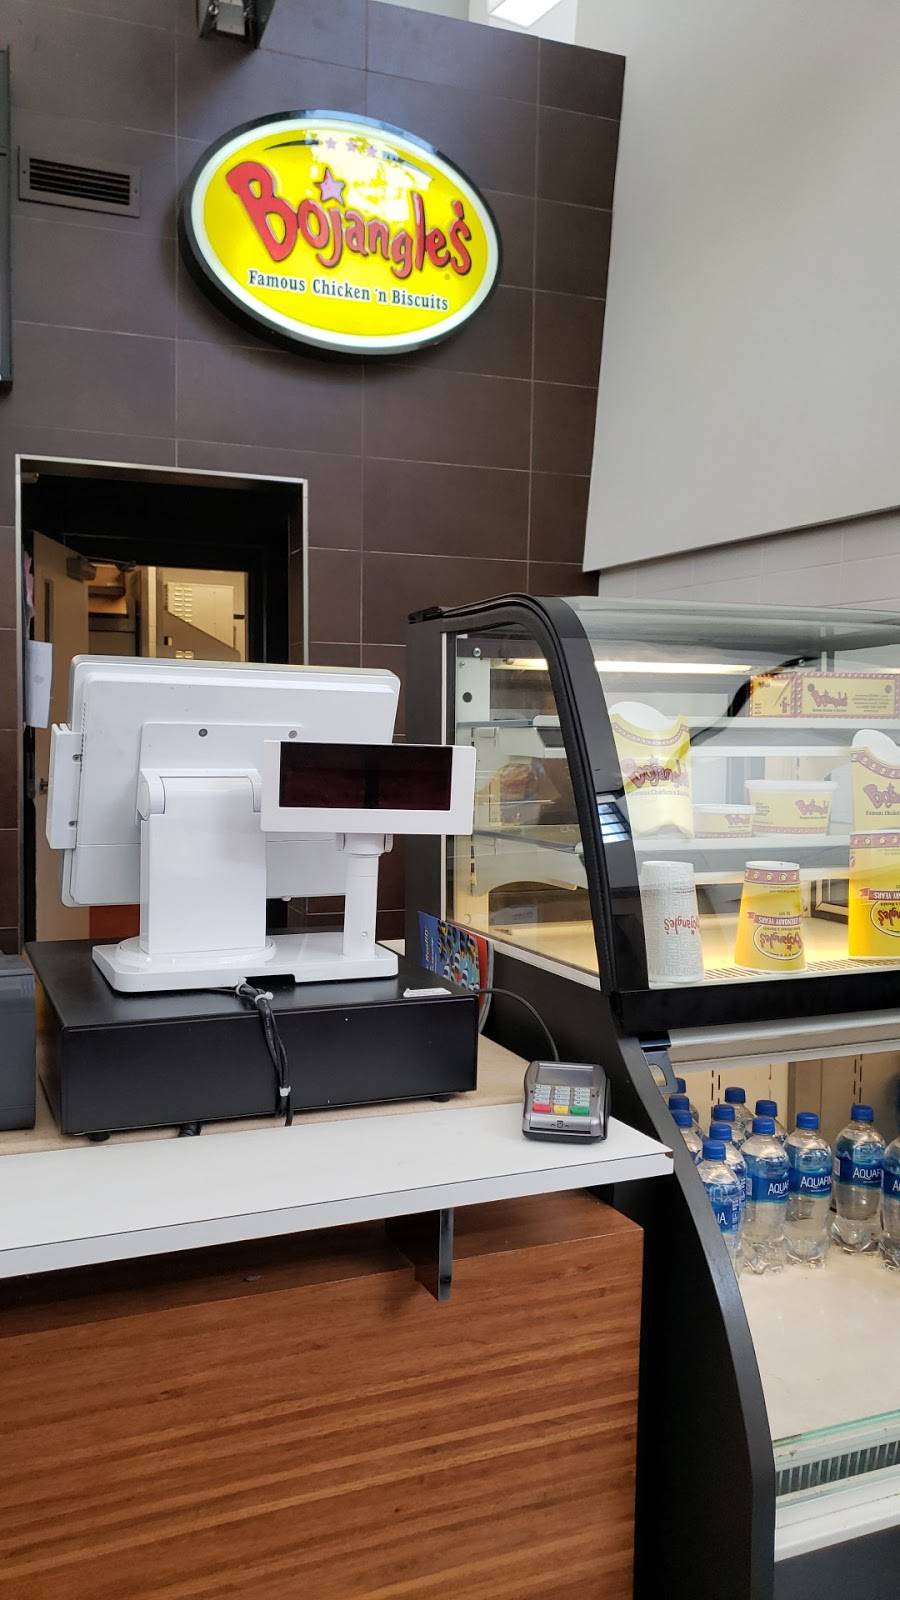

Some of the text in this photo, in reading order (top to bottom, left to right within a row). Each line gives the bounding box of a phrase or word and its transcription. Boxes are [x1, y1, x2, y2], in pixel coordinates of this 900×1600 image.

[225, 160, 472, 280] Bojangle's
[248, 269, 306, 292] Famous
[312, 279, 370, 301] Chicken
[391, 290, 449, 311] Biscuits
